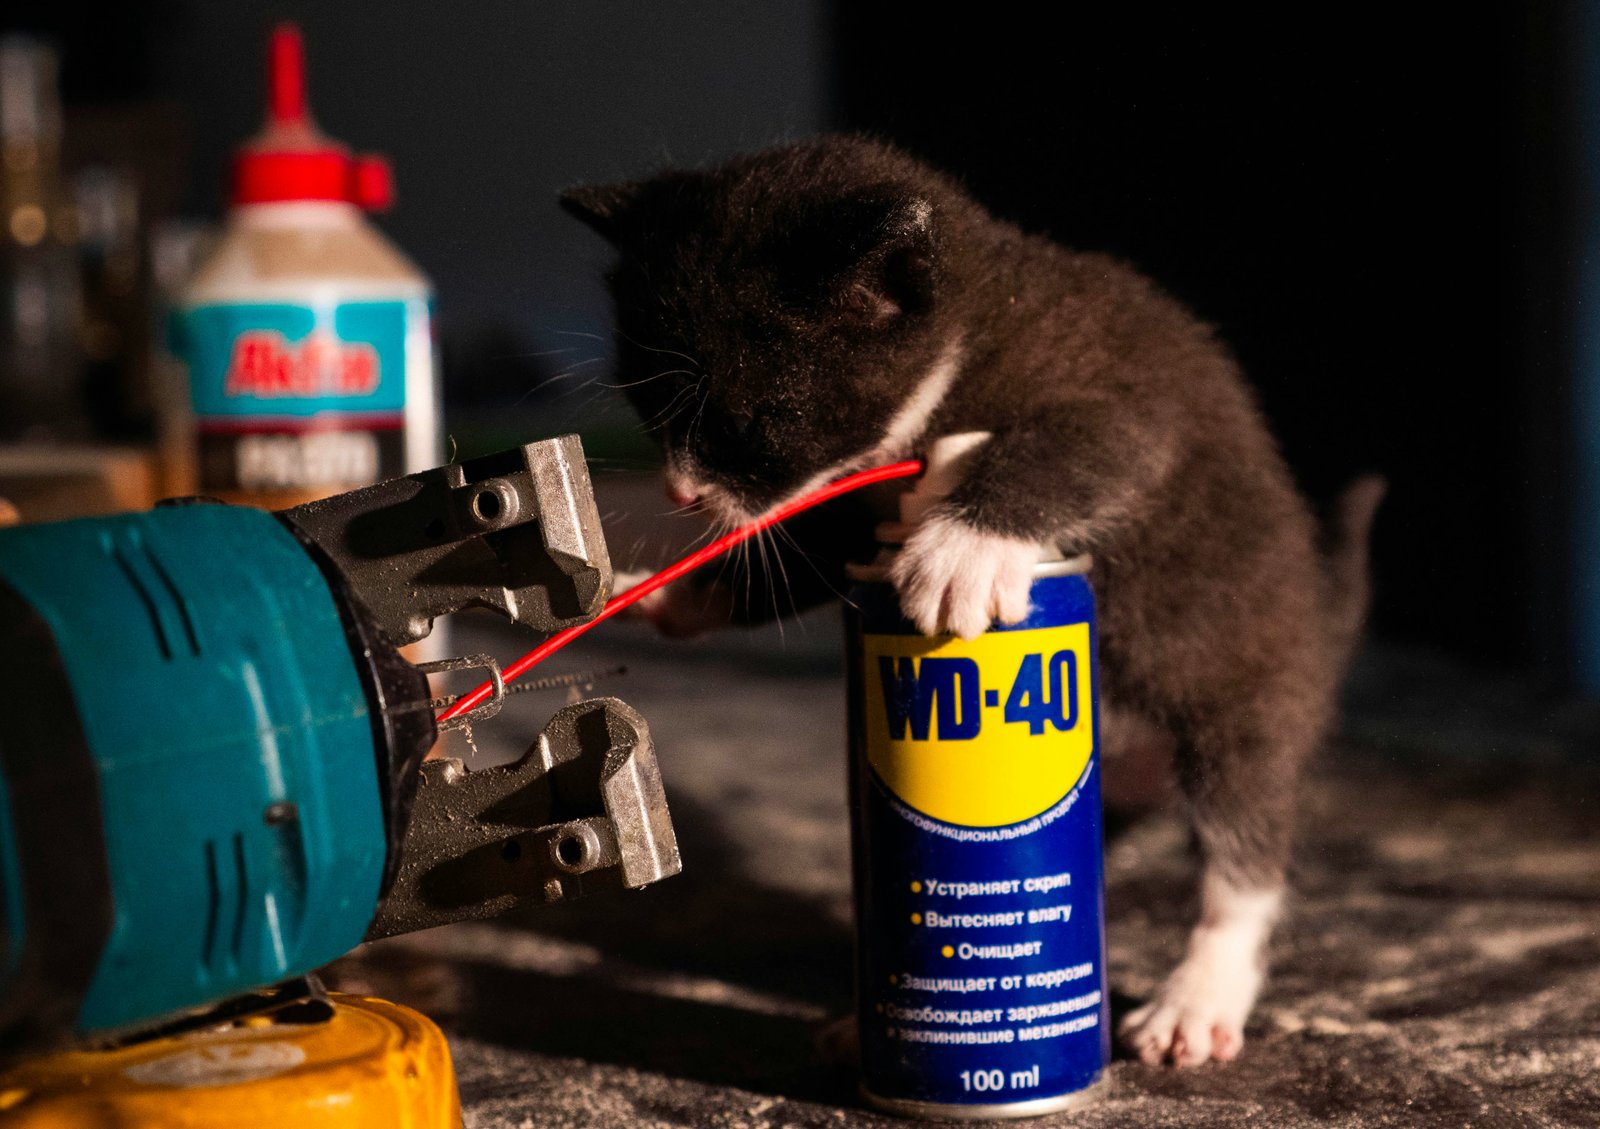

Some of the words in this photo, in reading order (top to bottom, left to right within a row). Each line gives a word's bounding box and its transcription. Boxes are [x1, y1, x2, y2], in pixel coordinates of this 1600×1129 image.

[878, 649, 1078, 741] WD-40
[1042, 789, 1079, 826] ПРОДУКТ
[925, 879, 1020, 899] Устраняет
[1024, 873, 1071, 895] скрип
[925, 910, 1023, 928] Вытесняет
[1028, 904, 1072, 924] влагу
[958, 940, 1042, 961] Очищает
[899, 973, 996, 993] Защищает
[1001, 976, 1021, 990] от
[1026, 962, 1093, 989] коррозии
[885, 1002, 1002, 1026] Освобождает
[1007, 990, 1101, 1023] заржавевшие
[1018, 1013, 1097, 1042] механизмы
[960, 1069, 1004, 1092] 100
[1010, 1065, 1039, 1088] ml
